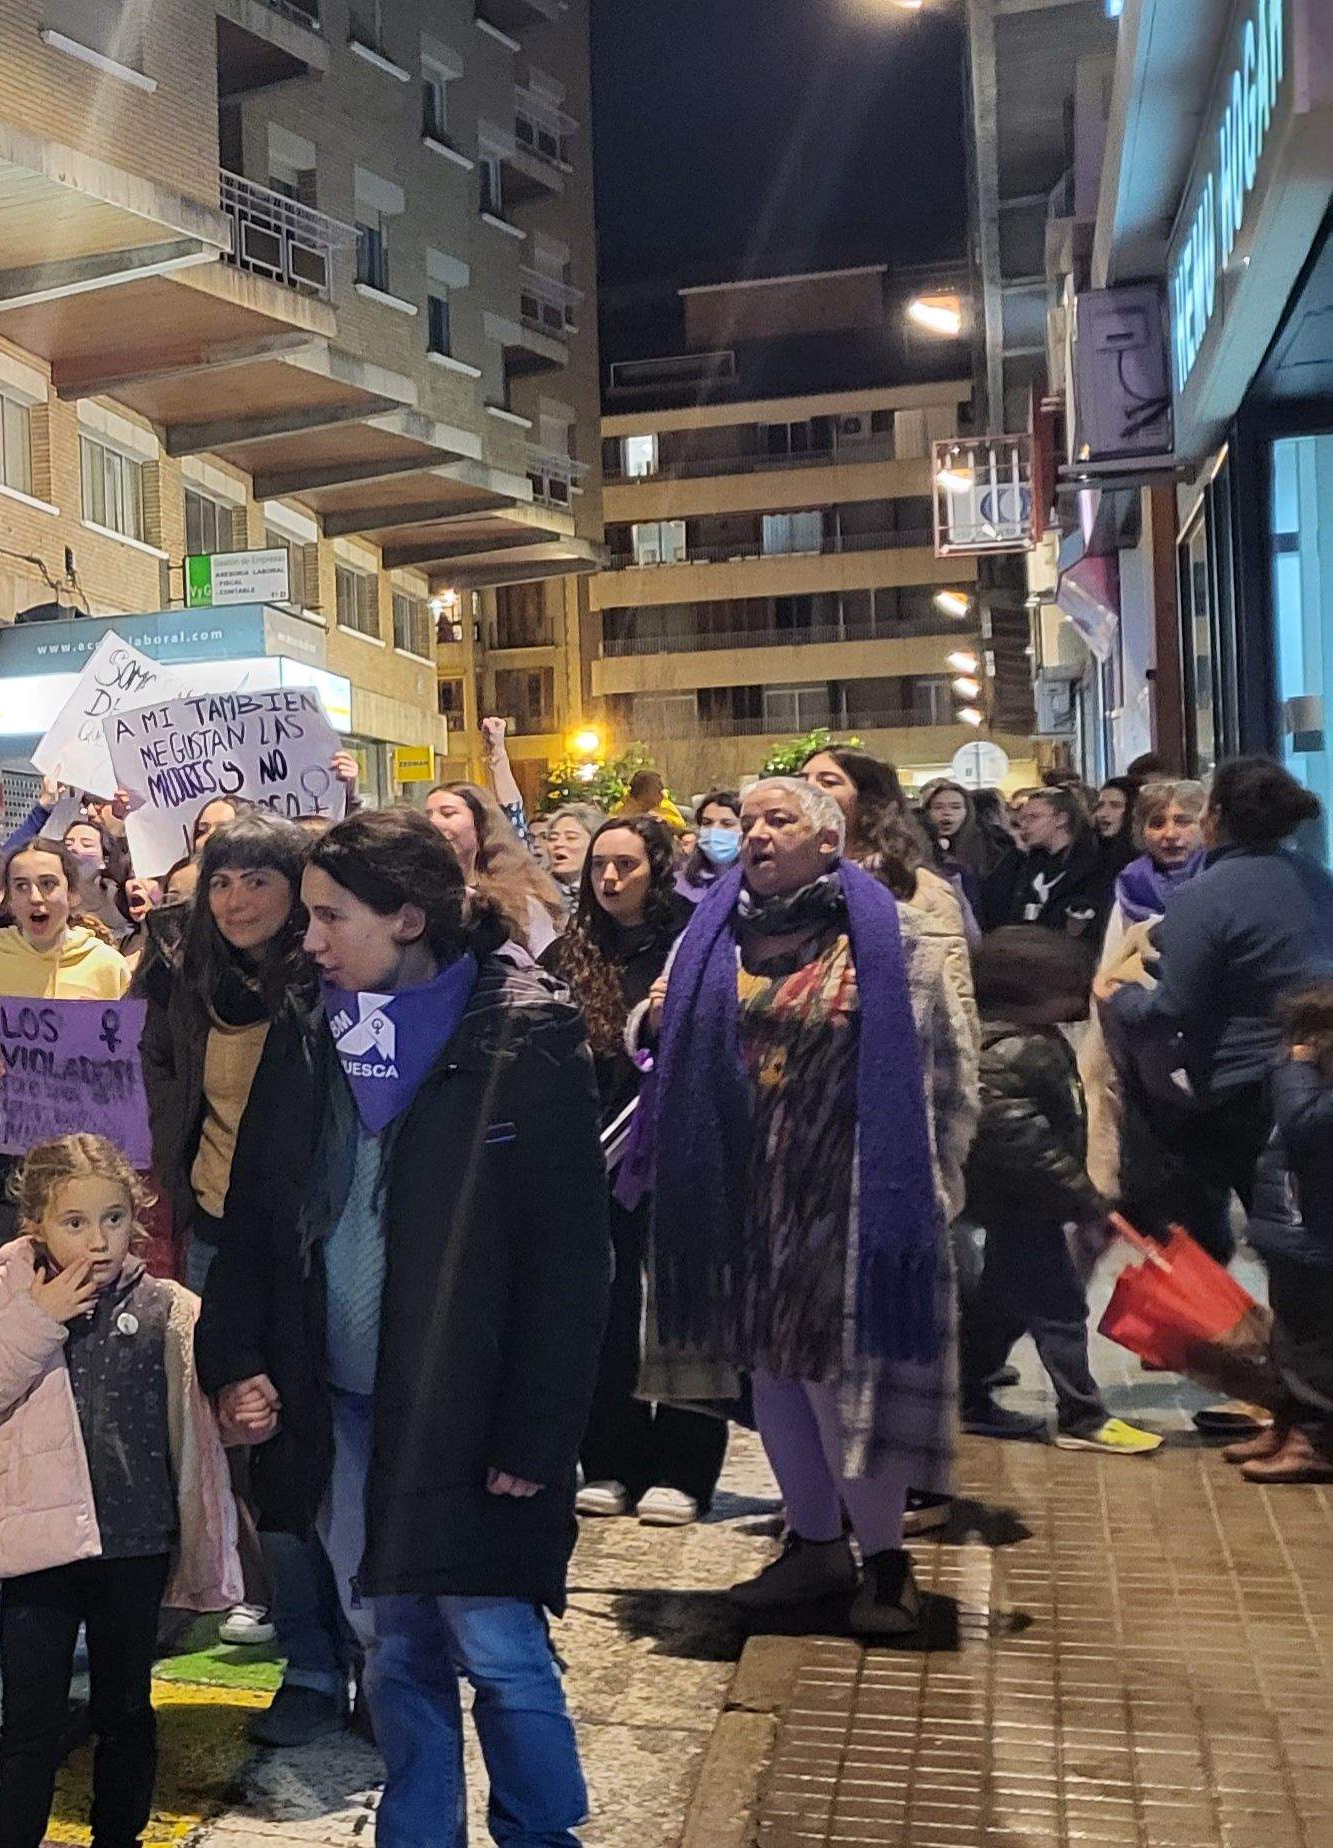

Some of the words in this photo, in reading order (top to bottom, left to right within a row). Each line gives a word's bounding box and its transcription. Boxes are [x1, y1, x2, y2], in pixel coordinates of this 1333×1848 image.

[116, 719, 135, 743] A
[142, 707, 175, 733] MI
[184, 691, 321, 726] TAMBIEN
[260, 715, 304, 745] LAS
[259, 749, 289, 785] NO
[0, 1006, 60, 1043] LOS
[341, 1059, 400, 1079] UESCA
